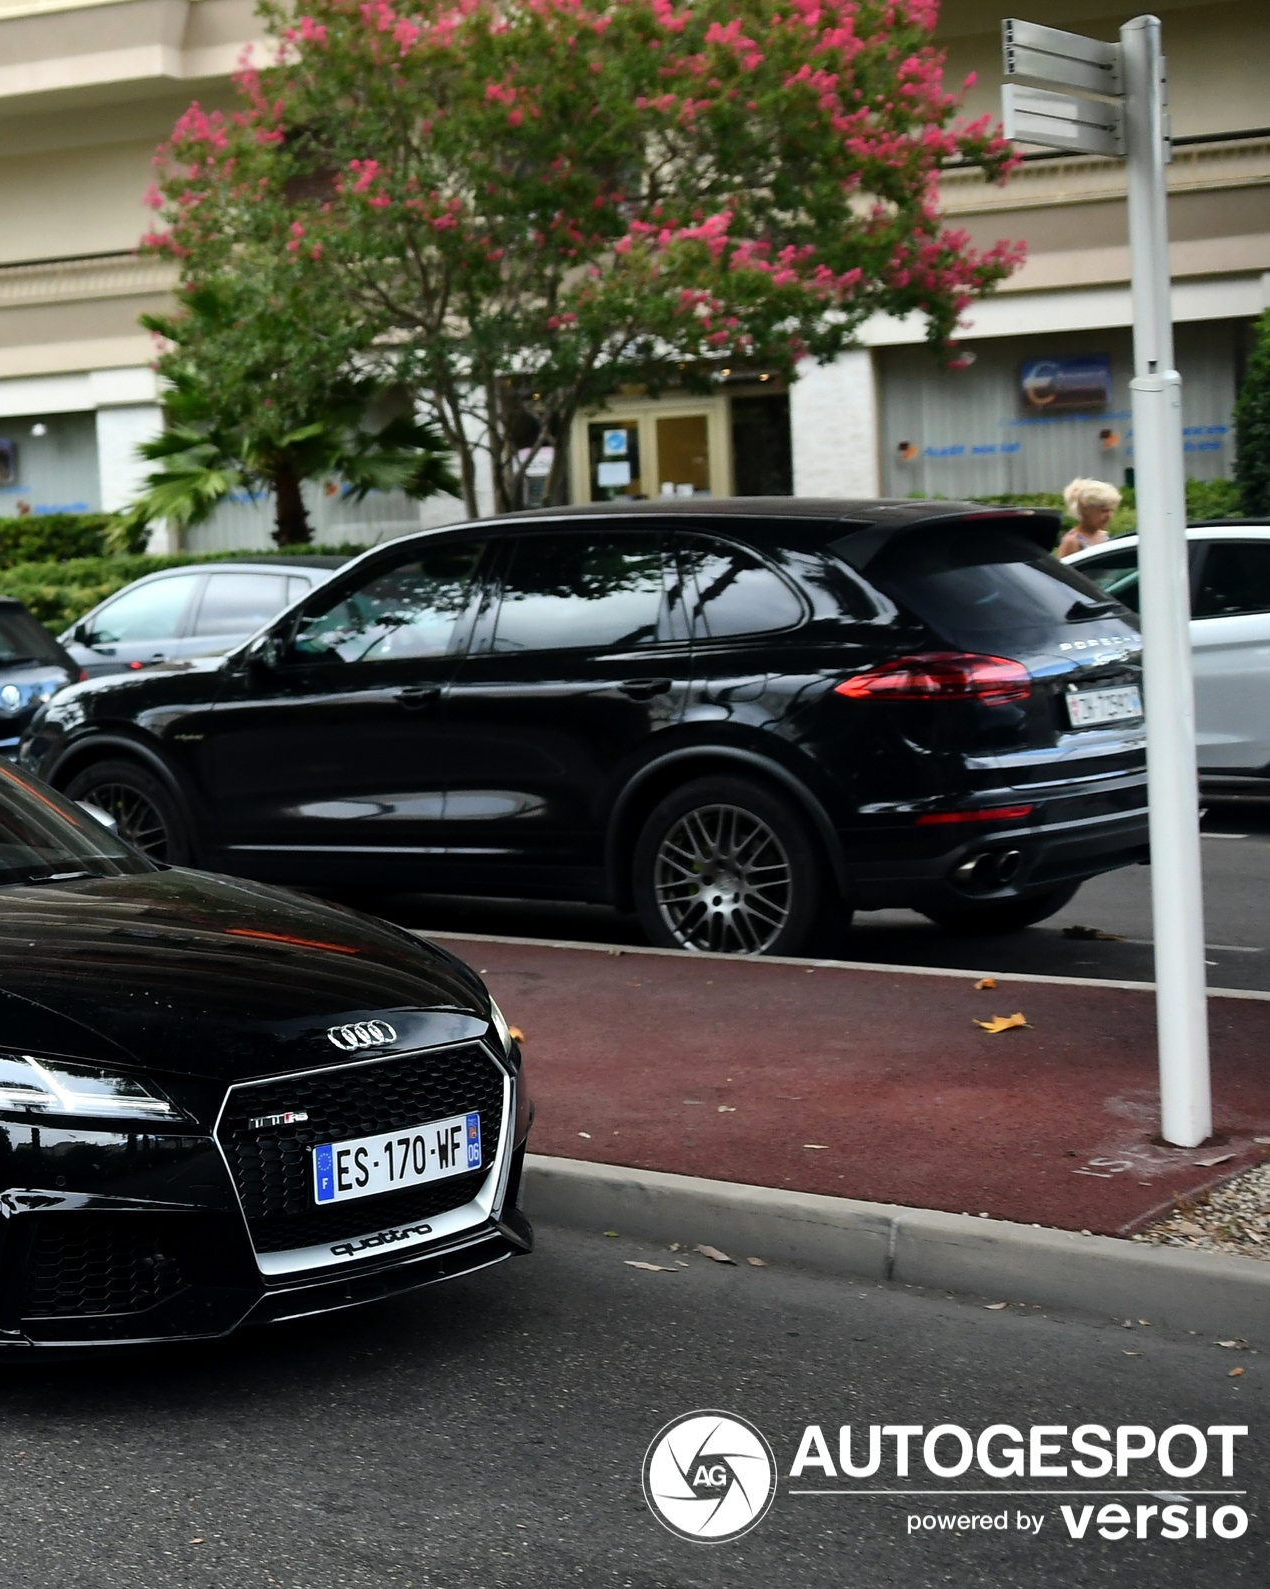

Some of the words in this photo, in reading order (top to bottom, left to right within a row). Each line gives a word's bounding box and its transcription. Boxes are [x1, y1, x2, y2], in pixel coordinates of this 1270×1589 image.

[468, 1142, 479, 1162] 06
[321, 1177, 329, 1190] F
[330, 1223, 433, 1257] quattro
